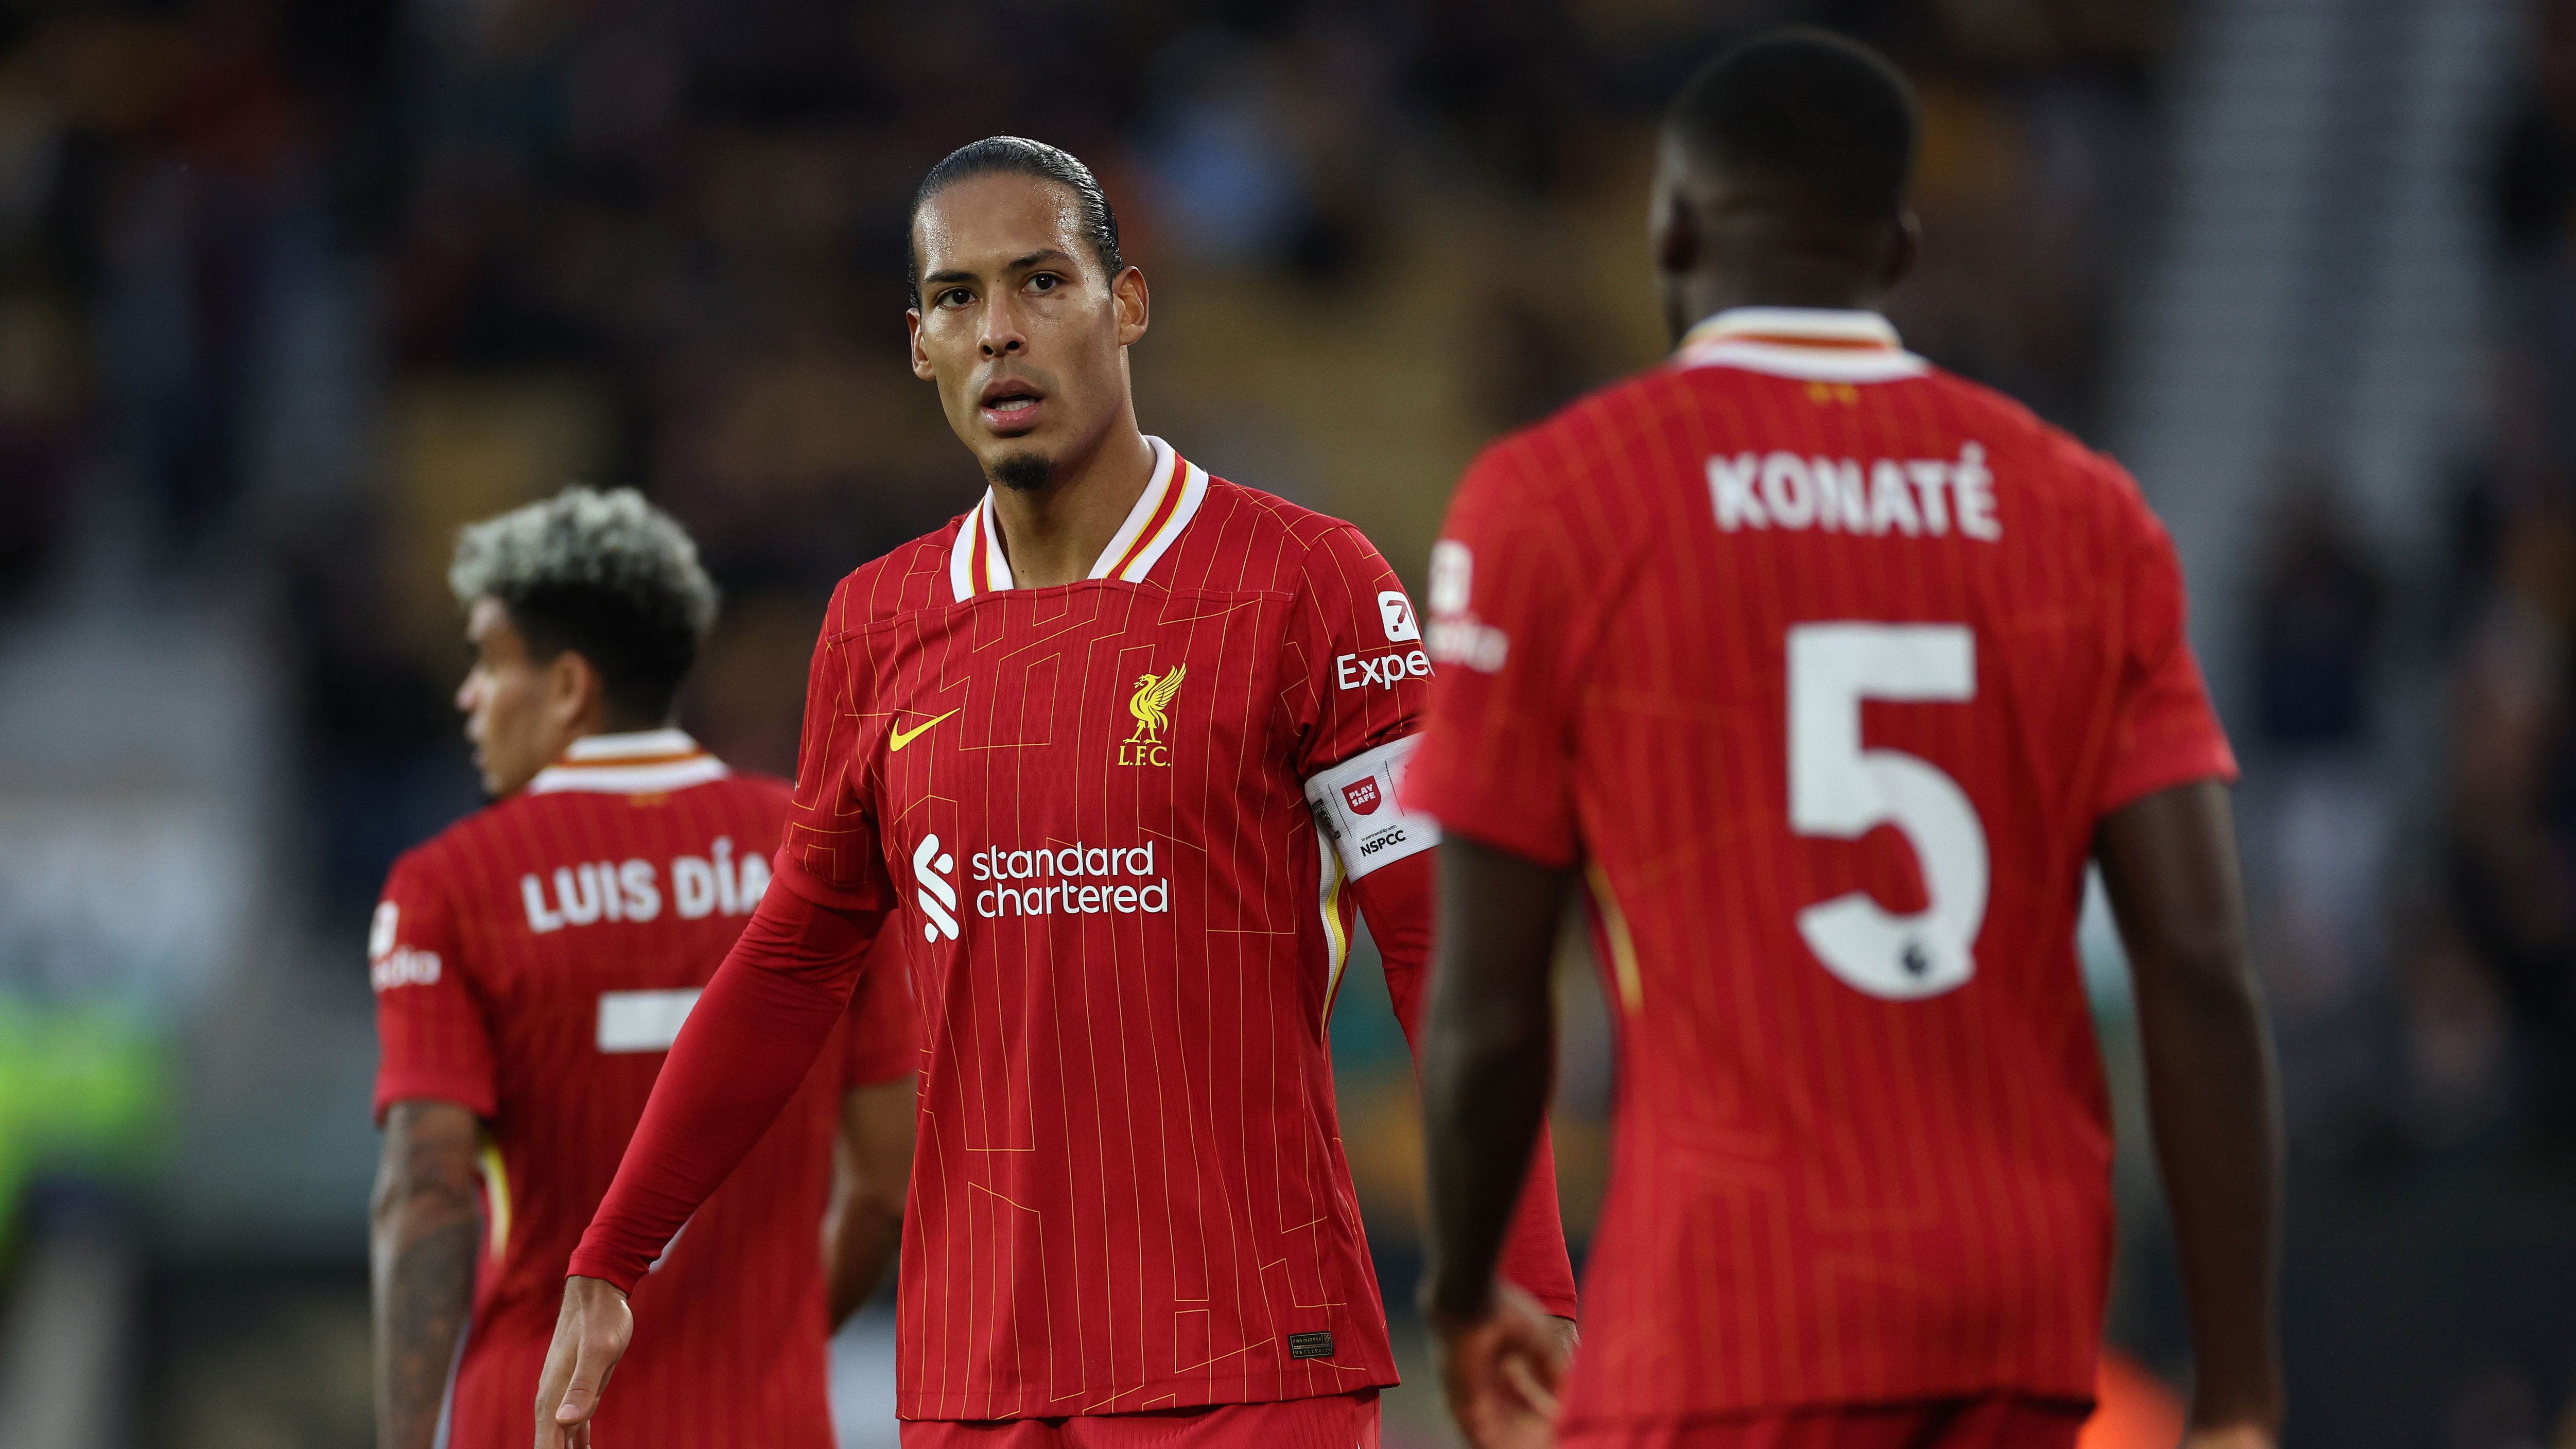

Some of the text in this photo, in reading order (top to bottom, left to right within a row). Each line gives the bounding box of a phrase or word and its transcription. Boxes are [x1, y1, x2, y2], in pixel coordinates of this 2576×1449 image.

[1705, 440, 2003, 544] KONATÉ
[1337, 650, 1436, 690] Expe
[1118, 745, 1172, 767] L.F.C.
[1349, 783, 1373, 800] PLAY
[1352, 791, 1376, 807] SAFE
[1785, 620, 1992, 1002] 5
[1360, 830, 1406, 857] NSPCC
[1365, 828, 1388, 840] partnership
[972, 840, 1154, 881] standard
[520, 858, 662, 934] LUIS
[977, 878, 1168, 918] chartered
